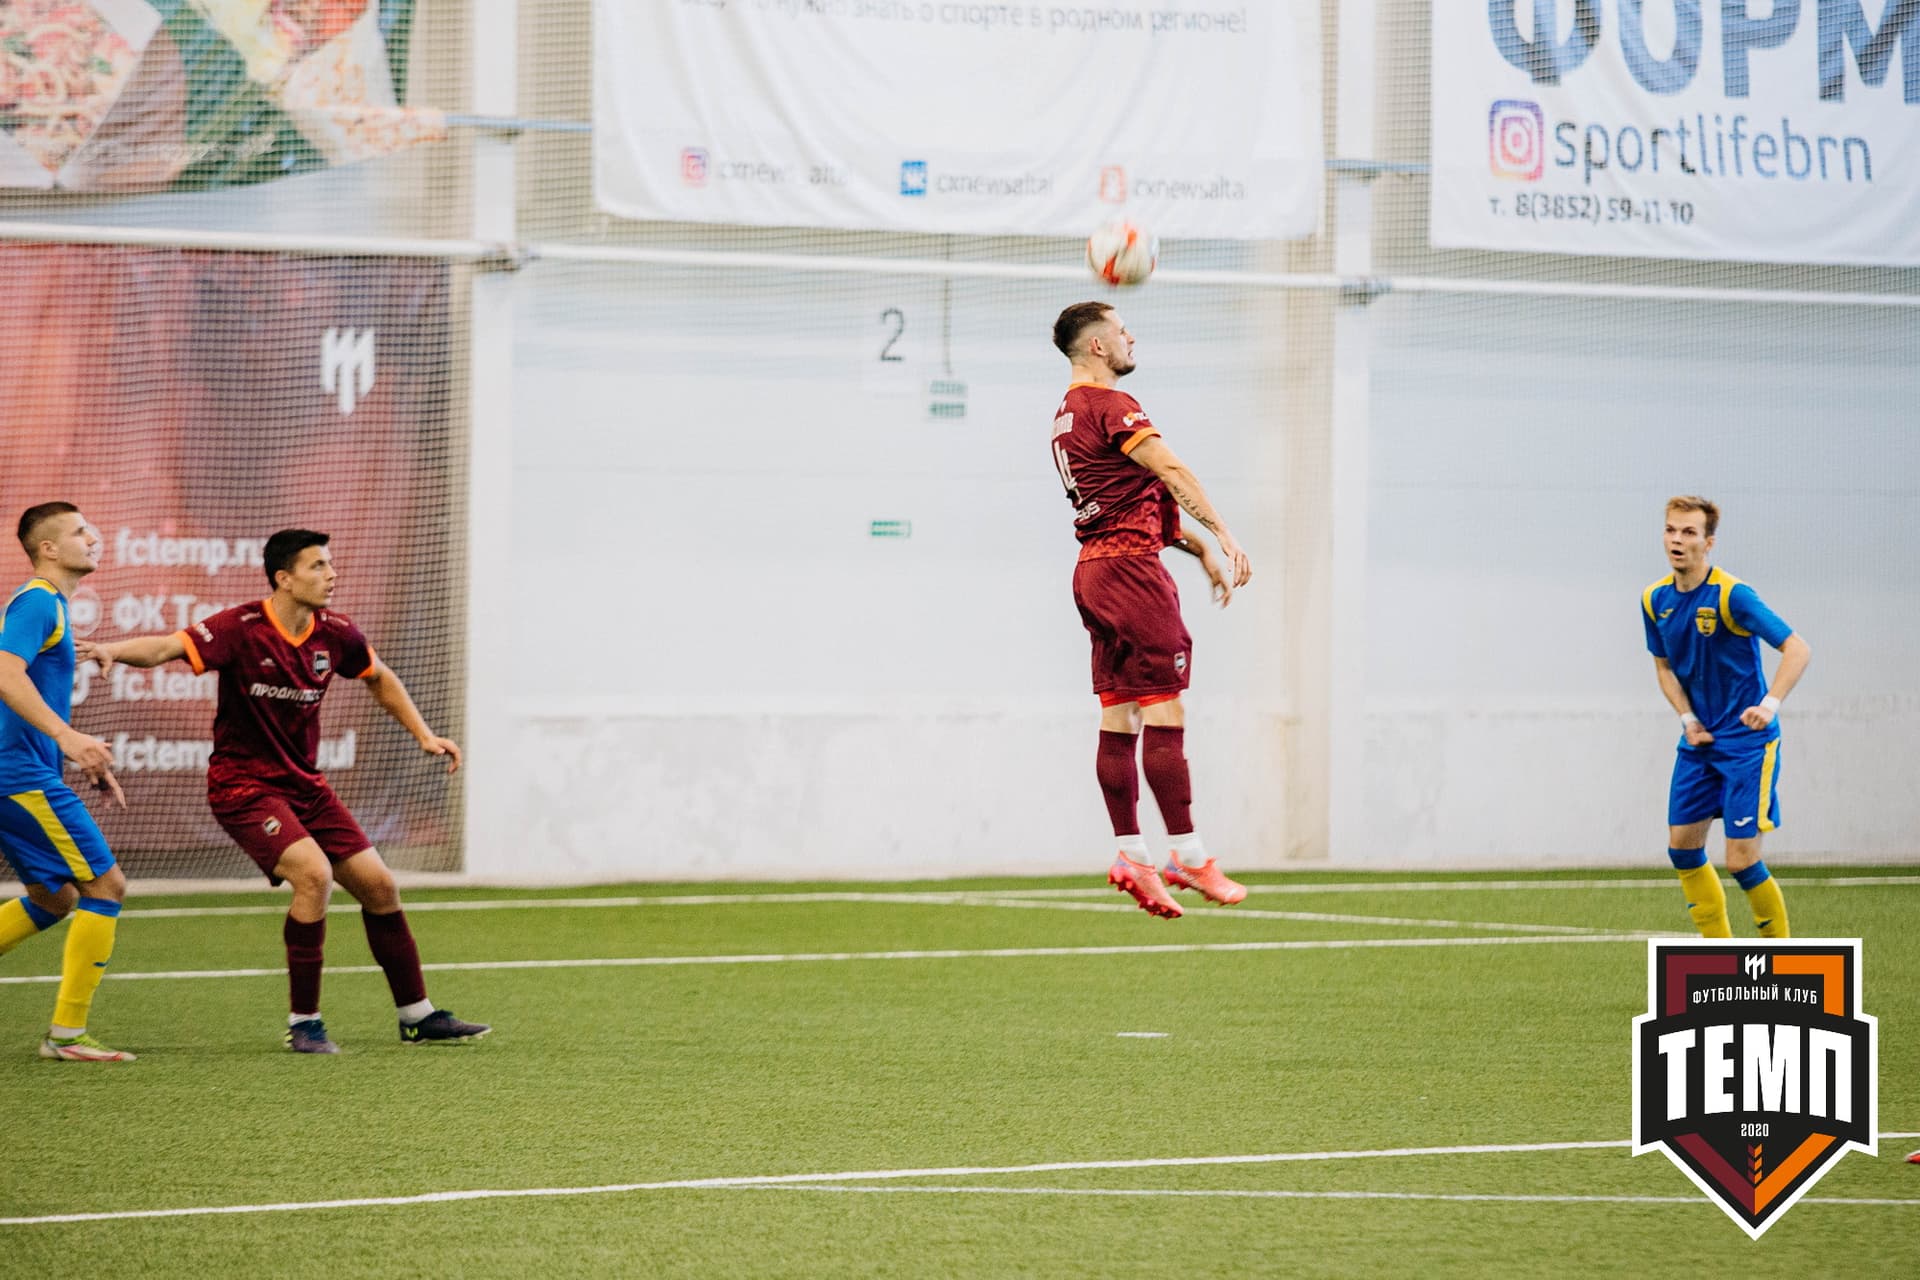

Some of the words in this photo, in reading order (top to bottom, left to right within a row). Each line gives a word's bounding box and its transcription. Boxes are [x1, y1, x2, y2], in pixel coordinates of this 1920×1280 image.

[940, 4, 1025, 31] спорте
[1050, 10, 1144, 35] родном
[1151, 8, 1248, 37] регионе!
[1554, 113, 1873, 184] sportlifebrn
[880, 307, 906, 362] 2
